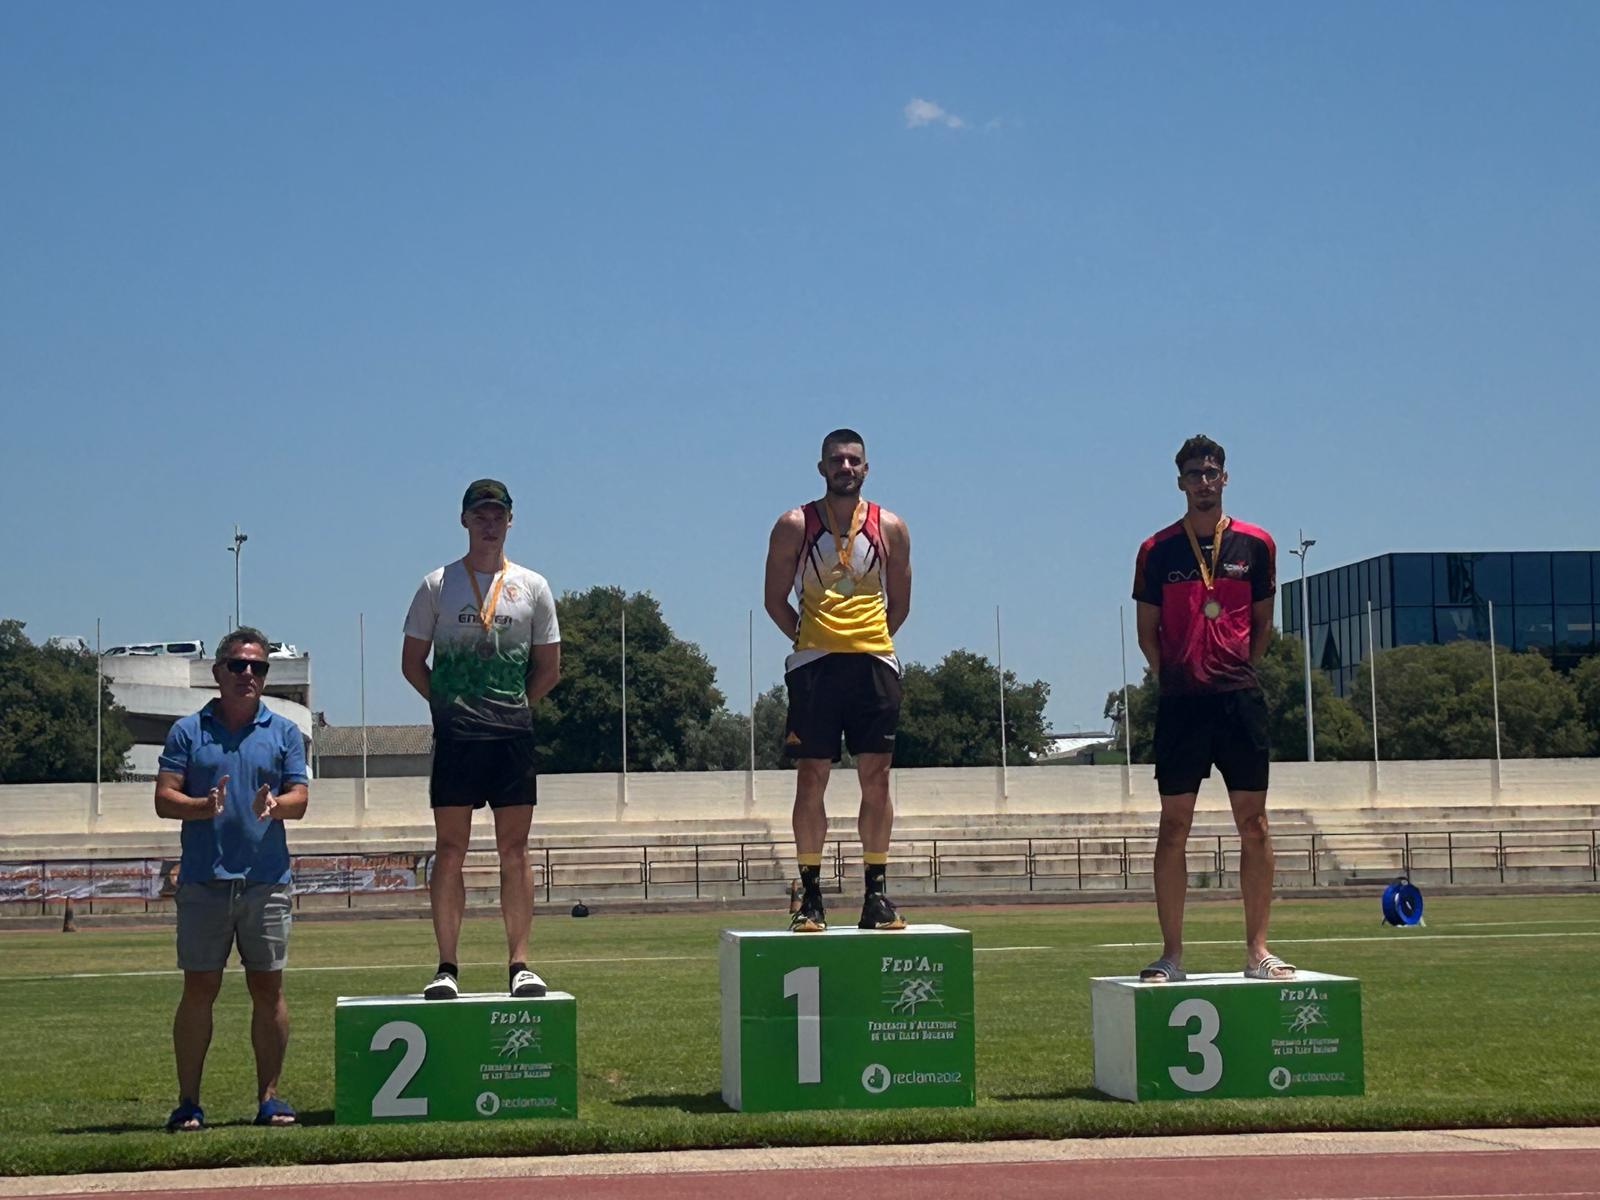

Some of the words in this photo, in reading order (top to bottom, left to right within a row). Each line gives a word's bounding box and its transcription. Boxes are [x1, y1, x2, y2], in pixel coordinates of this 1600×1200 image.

[370, 1020, 428, 1117] 2
[783, 966, 821, 1084] 1
[1168, 998, 1223, 1092] 3
